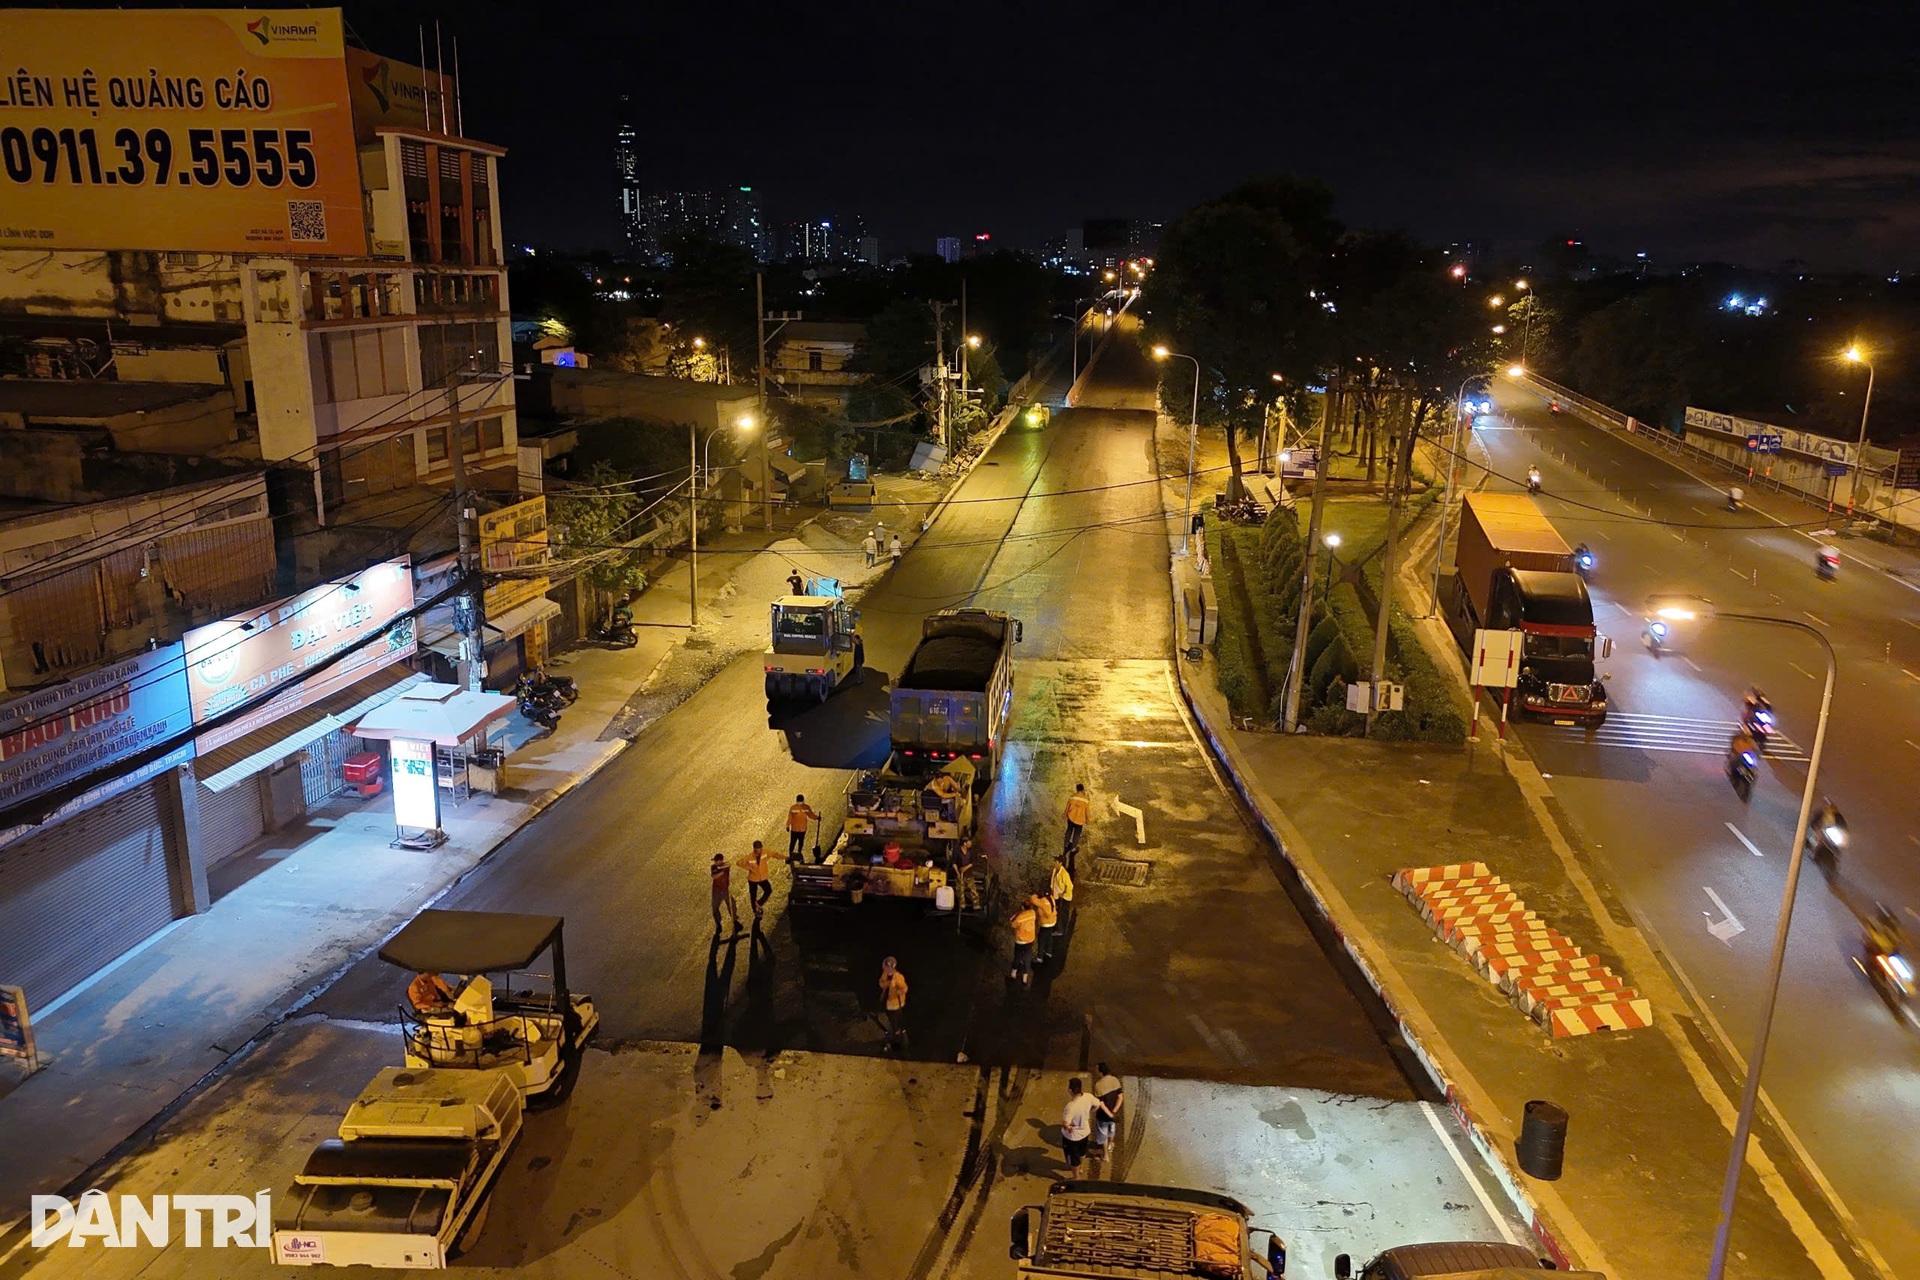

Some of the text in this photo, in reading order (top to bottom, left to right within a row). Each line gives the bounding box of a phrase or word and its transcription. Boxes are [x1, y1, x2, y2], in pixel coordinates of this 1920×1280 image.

[271, 25, 317, 35] VINAMA
[63, 68, 99, 117] HỆ
[108, 69, 204, 108] QUẢNG
[214, 69, 270, 109] CÁO
[1, 127, 317, 189] 0911.39.5555
[334, 601, 373, 632] VIỆT
[13, 703, 26, 718] TY
[29, 694, 56, 711] TNHH
[92, 671, 114, 690] ĐIỆN
[115, 662, 140, 683] LẠNH
[250, 673, 267, 690] CÀ
[269, 661, 294, 683] PHÊ
[0, 682, 131, 761] BẢO NHƯ
[147, 719, 168, 740] LẠNH
[41, 746, 66, 766] CUNG
[66, 737, 85, 759] CẤP
